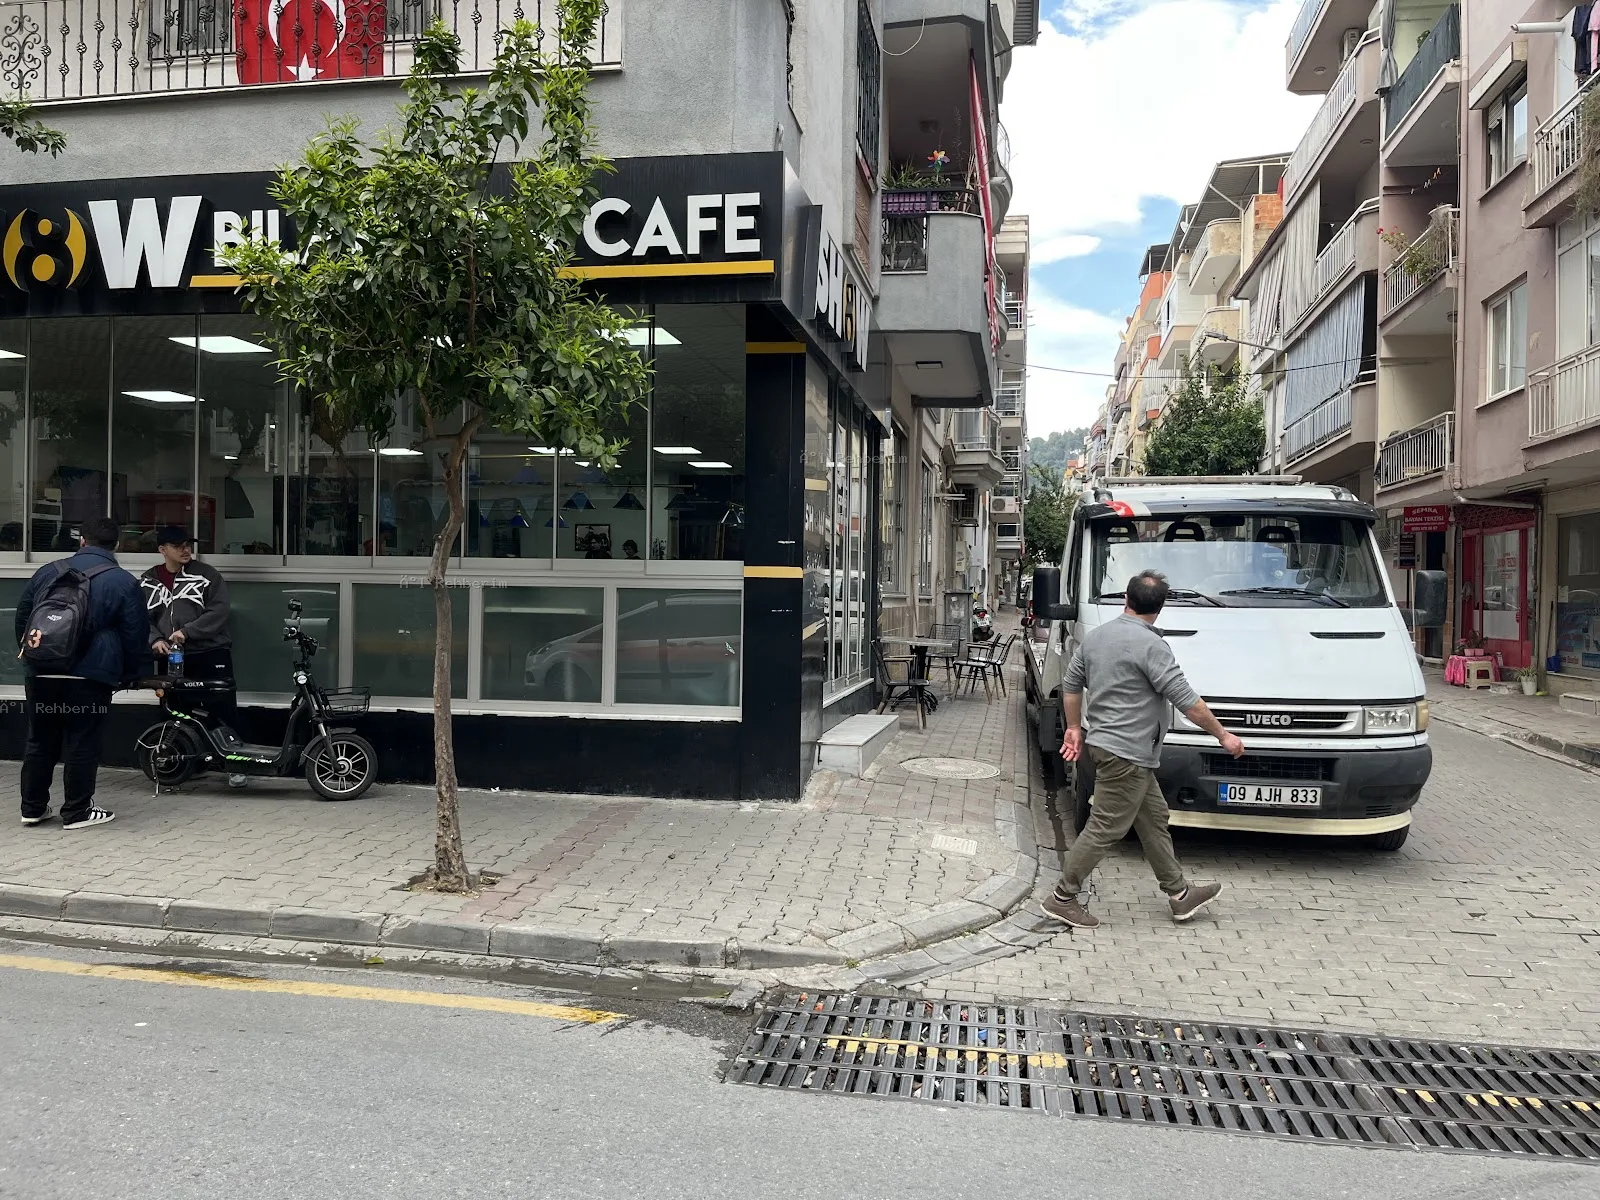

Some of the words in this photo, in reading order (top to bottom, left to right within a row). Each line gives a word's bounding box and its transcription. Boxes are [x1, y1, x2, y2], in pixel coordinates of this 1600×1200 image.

[582, 192, 761, 257] CAFE
[1412, 507, 1438, 515] SEMRA
[1245, 713, 1292, 727] IVECO
[1229, 786, 1246, 800] 09
[1255, 787, 1282, 802] AJH
[1291, 788, 1318, 803] 833
